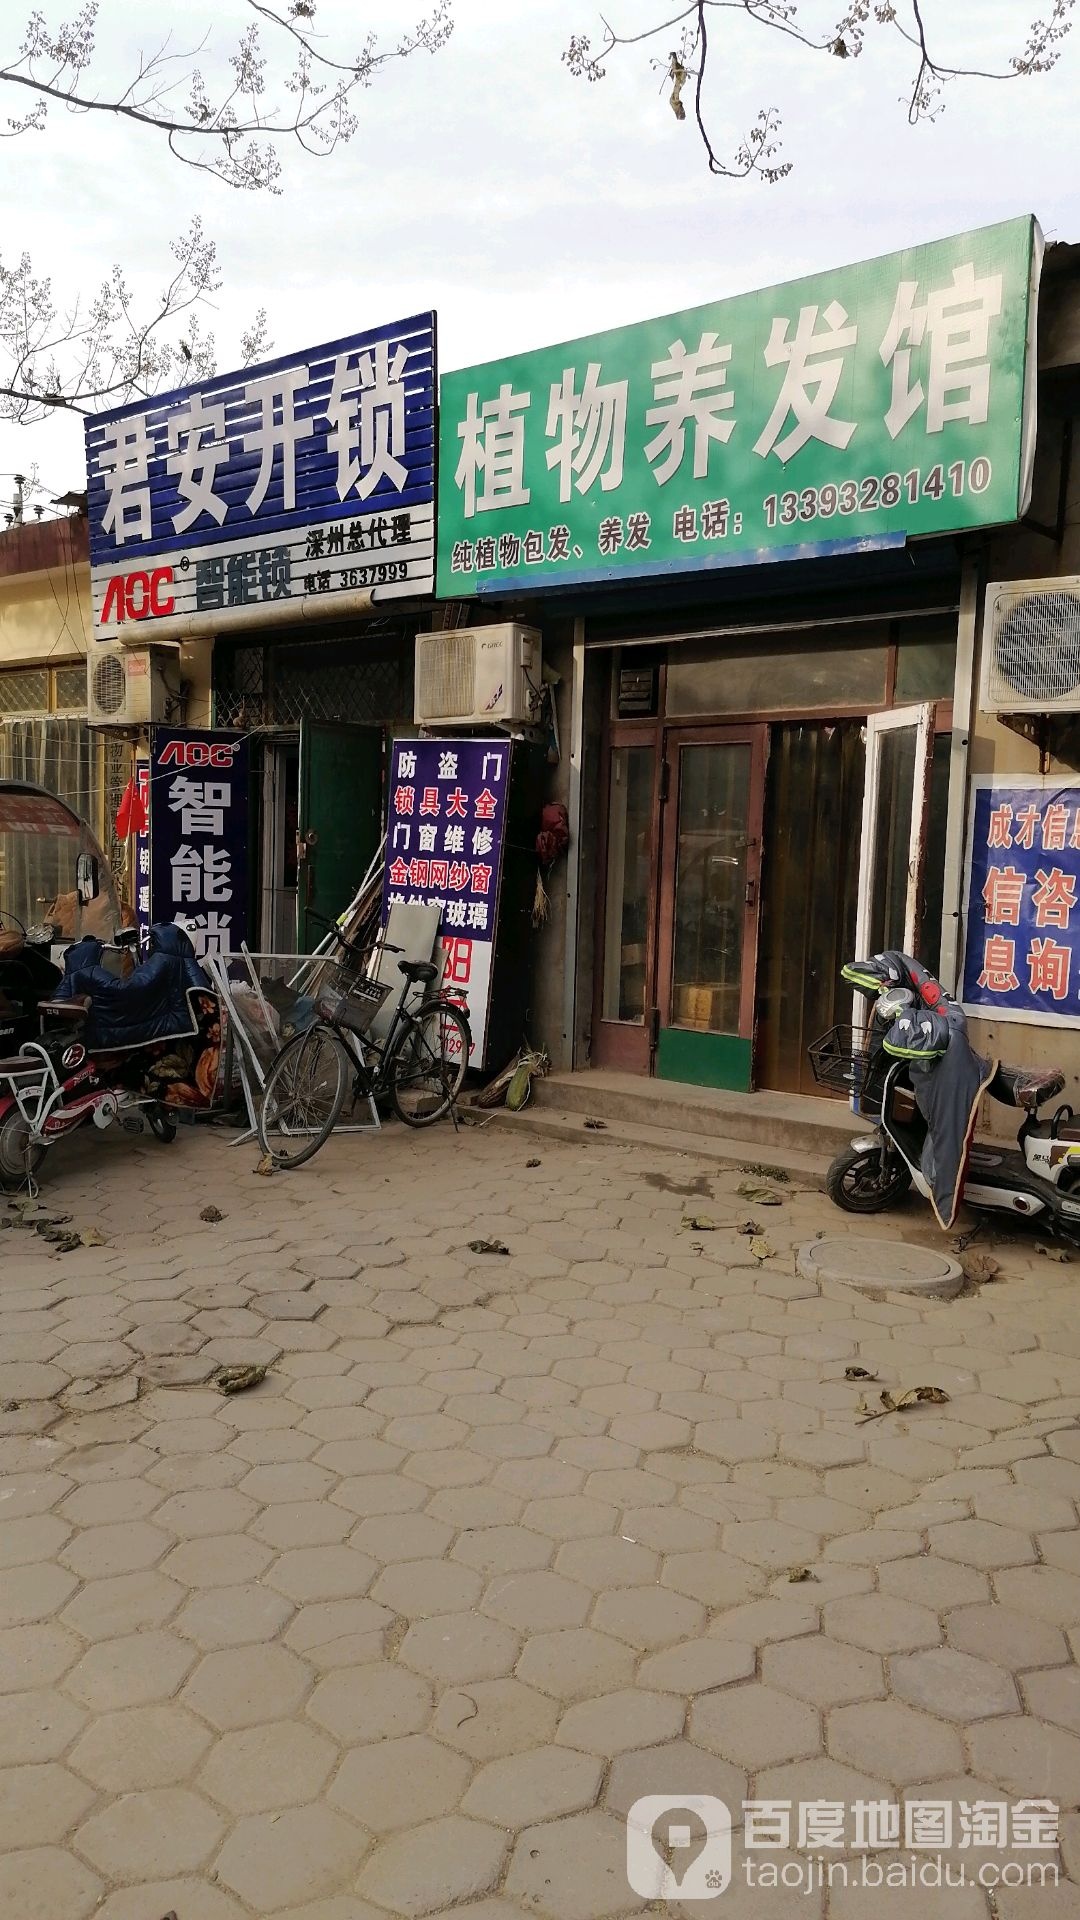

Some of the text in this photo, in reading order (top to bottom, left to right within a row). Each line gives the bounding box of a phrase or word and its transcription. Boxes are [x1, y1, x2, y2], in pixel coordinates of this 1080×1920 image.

[454, 263, 1003, 518] 植物养发馆
[99, 339, 410, 546] 君安开锁
[763, 456, 992, 527] 13393281410
[305, 513, 411, 557] 深州总代理
[100, 566, 176, 623] AOC
[195, 547, 292, 610] 智能锁
[304, 562, 407, 592] 电话 3637999
[397, 750, 503, 782] 防盗门
[393, 785, 498, 819] 锁具大全
[392, 822, 494, 856] 门窗维修
[388, 856, 492, 895] 金钢网纱窗
